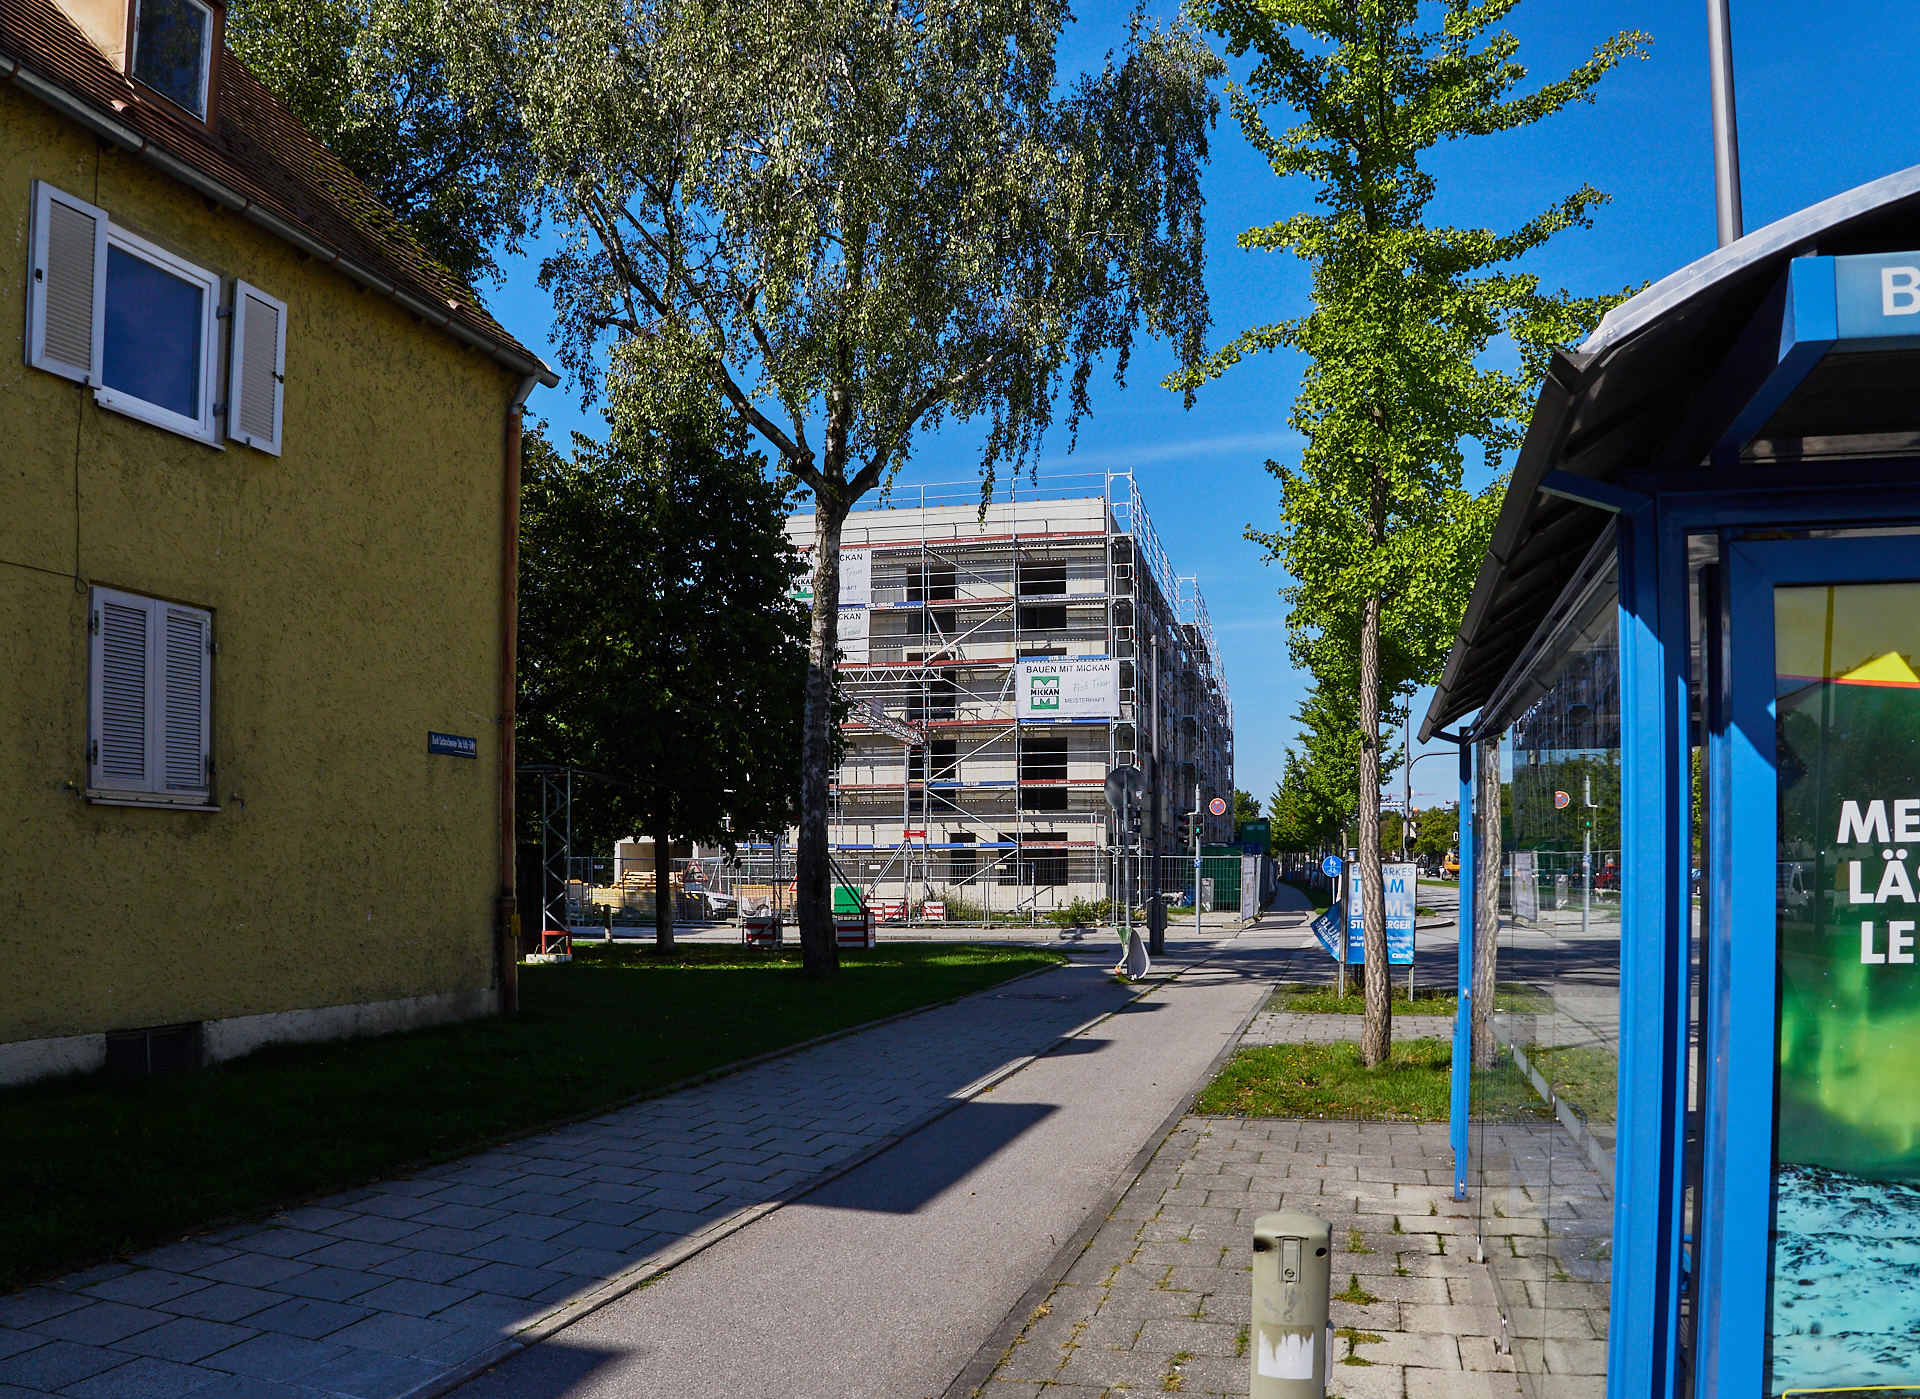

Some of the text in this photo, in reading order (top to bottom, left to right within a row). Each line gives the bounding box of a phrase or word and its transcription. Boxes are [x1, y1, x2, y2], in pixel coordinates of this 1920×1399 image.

[1026, 664, 1110, 674] BAUEN MIT MICKAN
[1092, 678, 1111, 689] Team
[1030, 688, 1060, 696] MICKAN
[1382, 867, 1413, 876] ARKES
[1849, 848, 1920, 903] LÄ
[1350, 899, 1412, 917] BME
